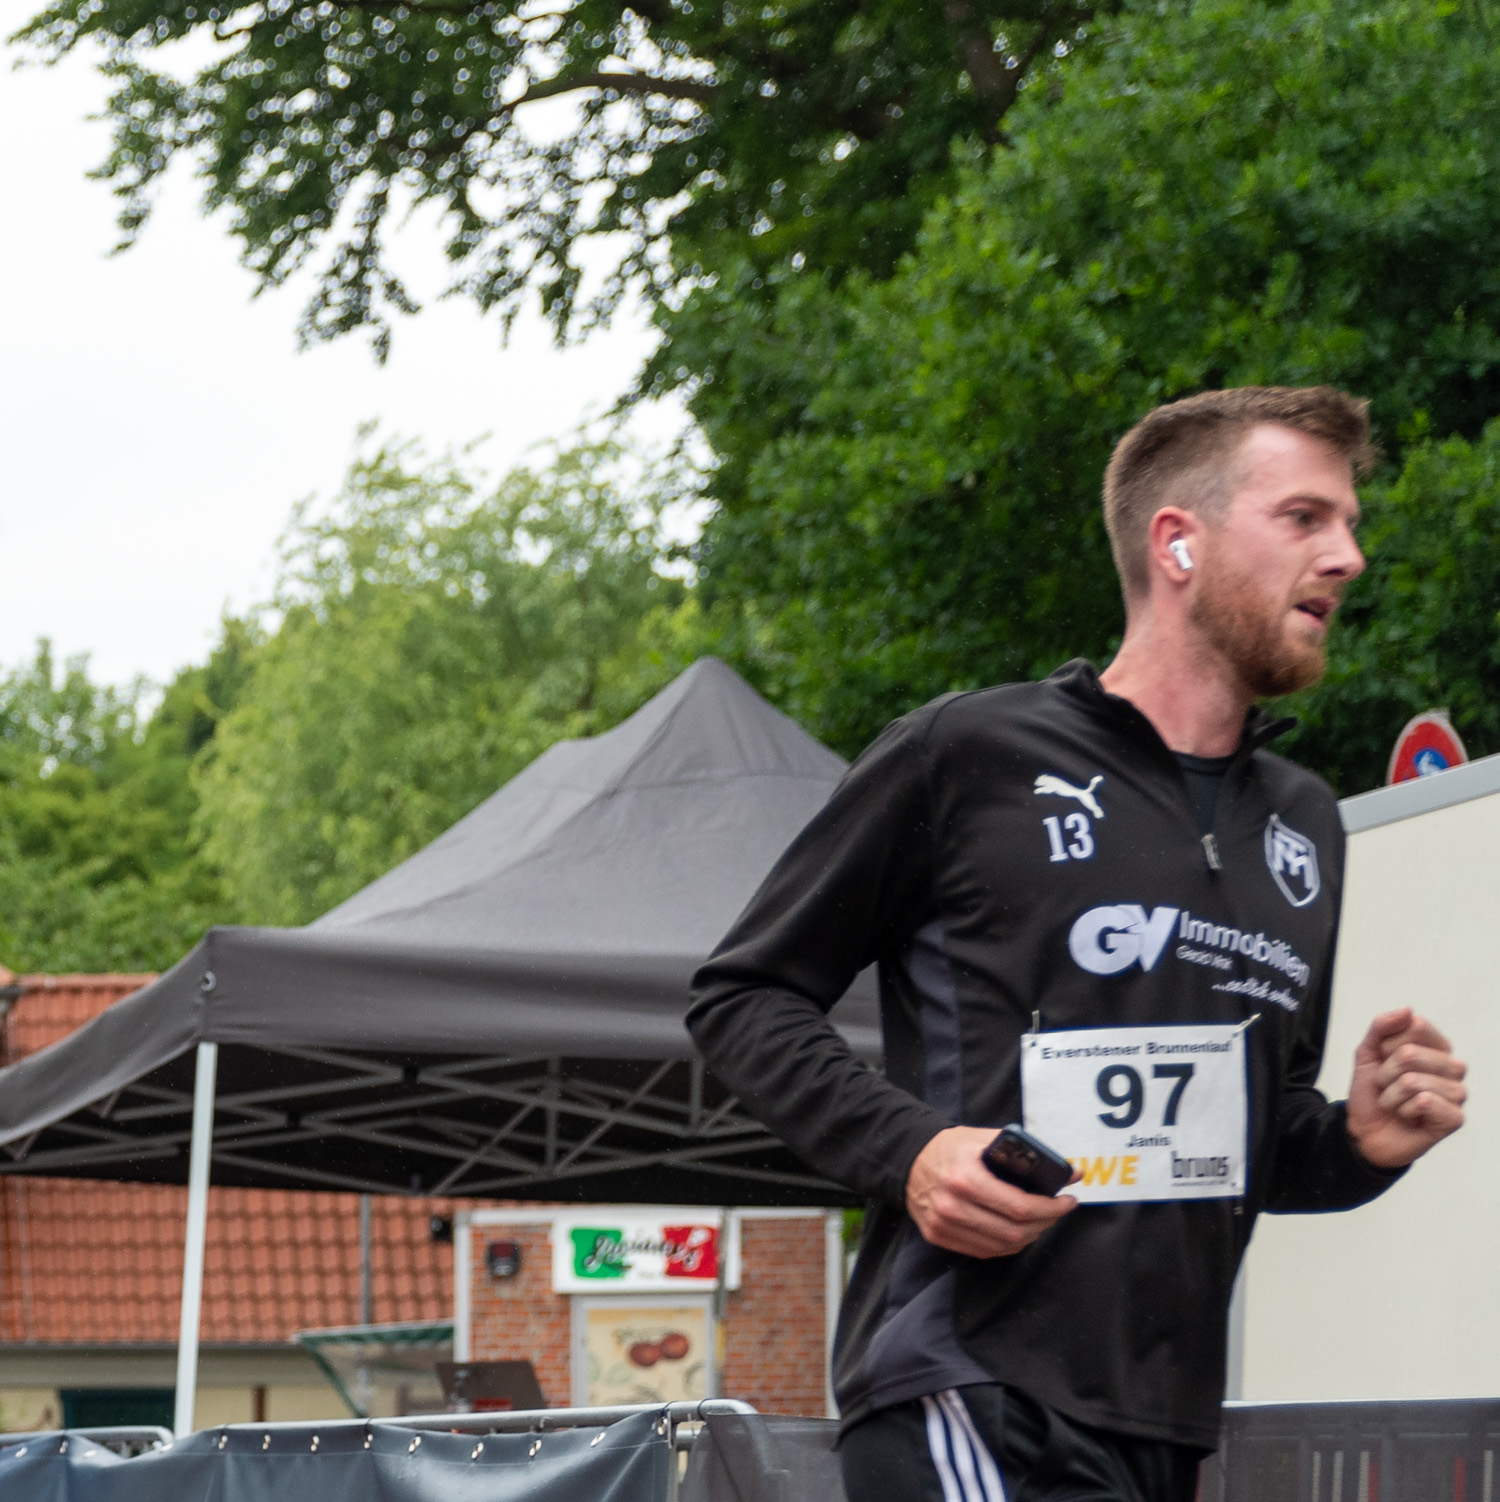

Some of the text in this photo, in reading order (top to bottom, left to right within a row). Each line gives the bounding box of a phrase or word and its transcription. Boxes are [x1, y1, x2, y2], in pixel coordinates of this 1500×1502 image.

[1043, 813, 1095, 862] 13
[1068, 903, 1180, 976] GV
[1095, 1062, 1196, 1129] 97
[1126, 1134, 1172, 1148] Janis
[1171, 1150, 1230, 1179] bruns
